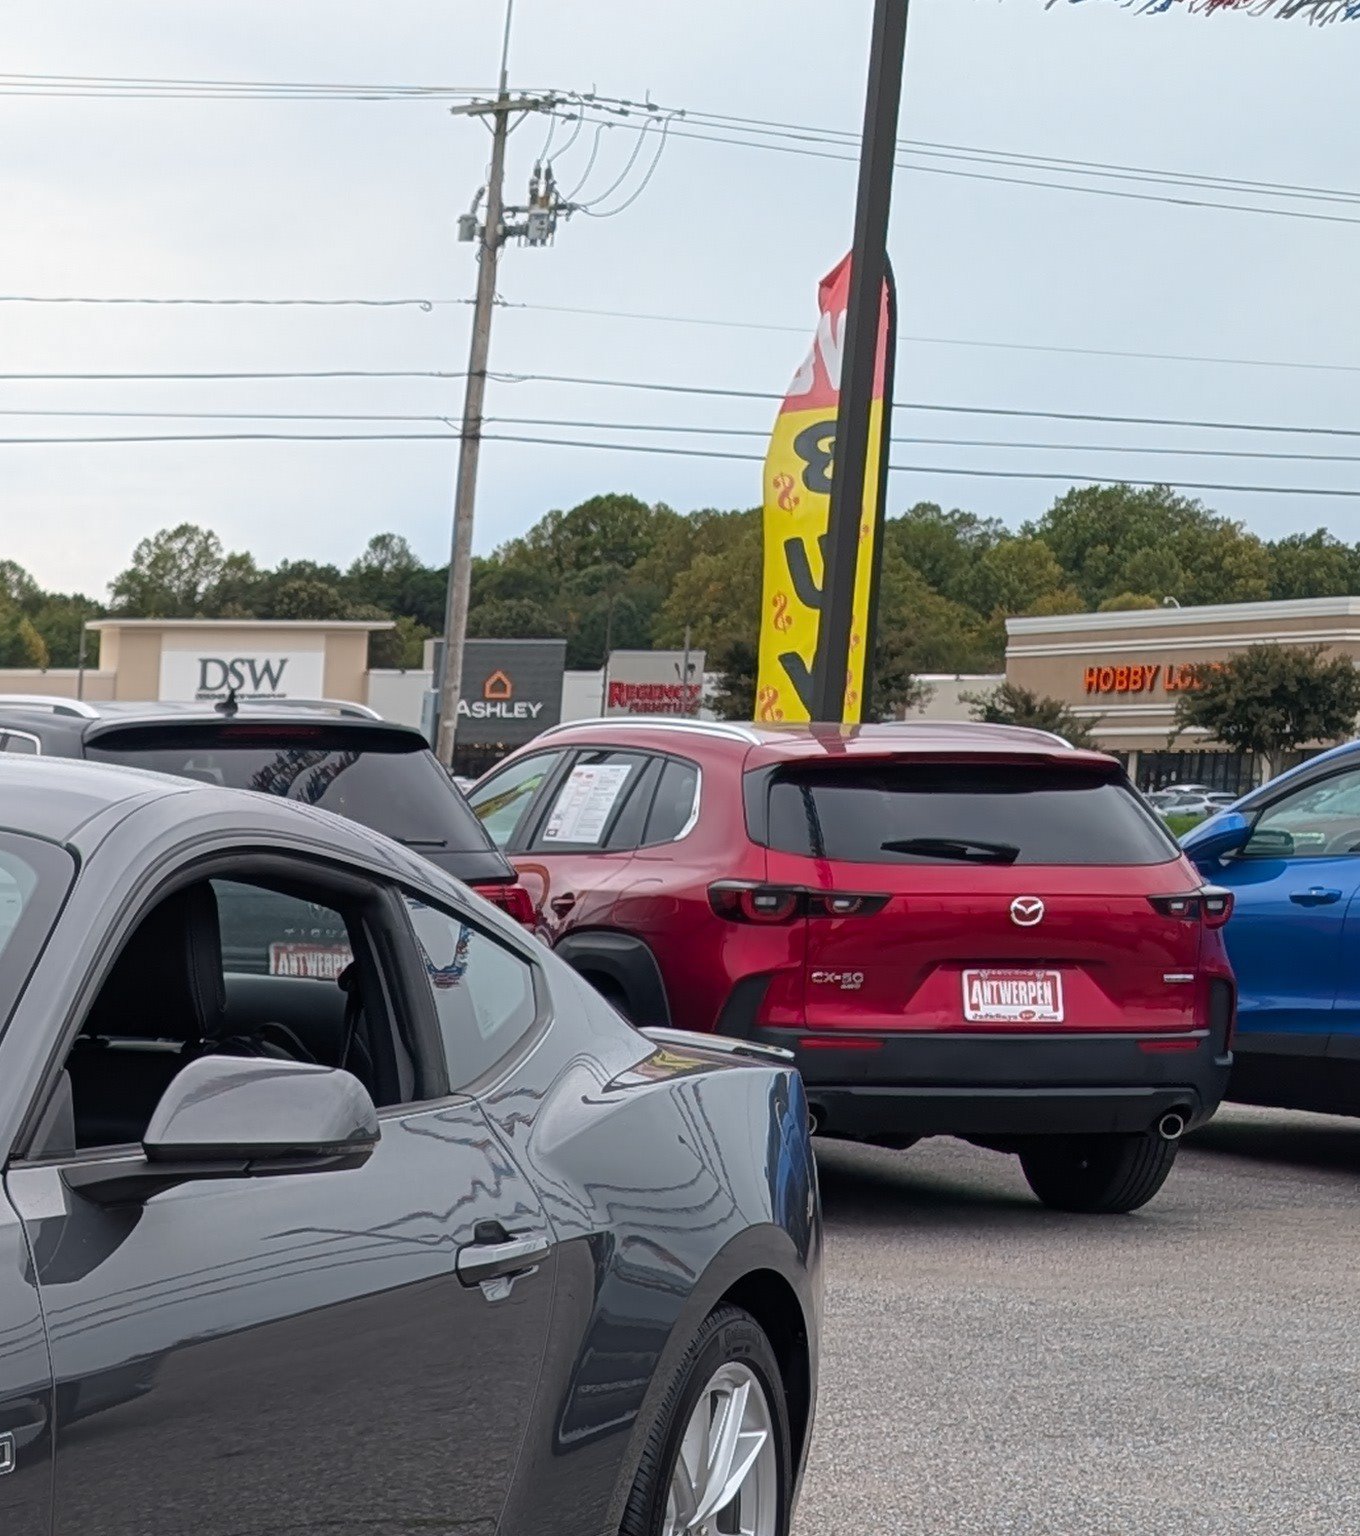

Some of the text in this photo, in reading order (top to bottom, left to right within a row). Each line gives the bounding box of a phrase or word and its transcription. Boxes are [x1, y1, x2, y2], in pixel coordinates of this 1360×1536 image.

[198, 657, 288, 691] DSW
[1083, 664, 1159, 693] HOBBY
[456, 699, 543, 718] ASHLEY
[811, 971, 865, 984] CX-50
[970, 980, 1053, 1006] ANTWERPEN
